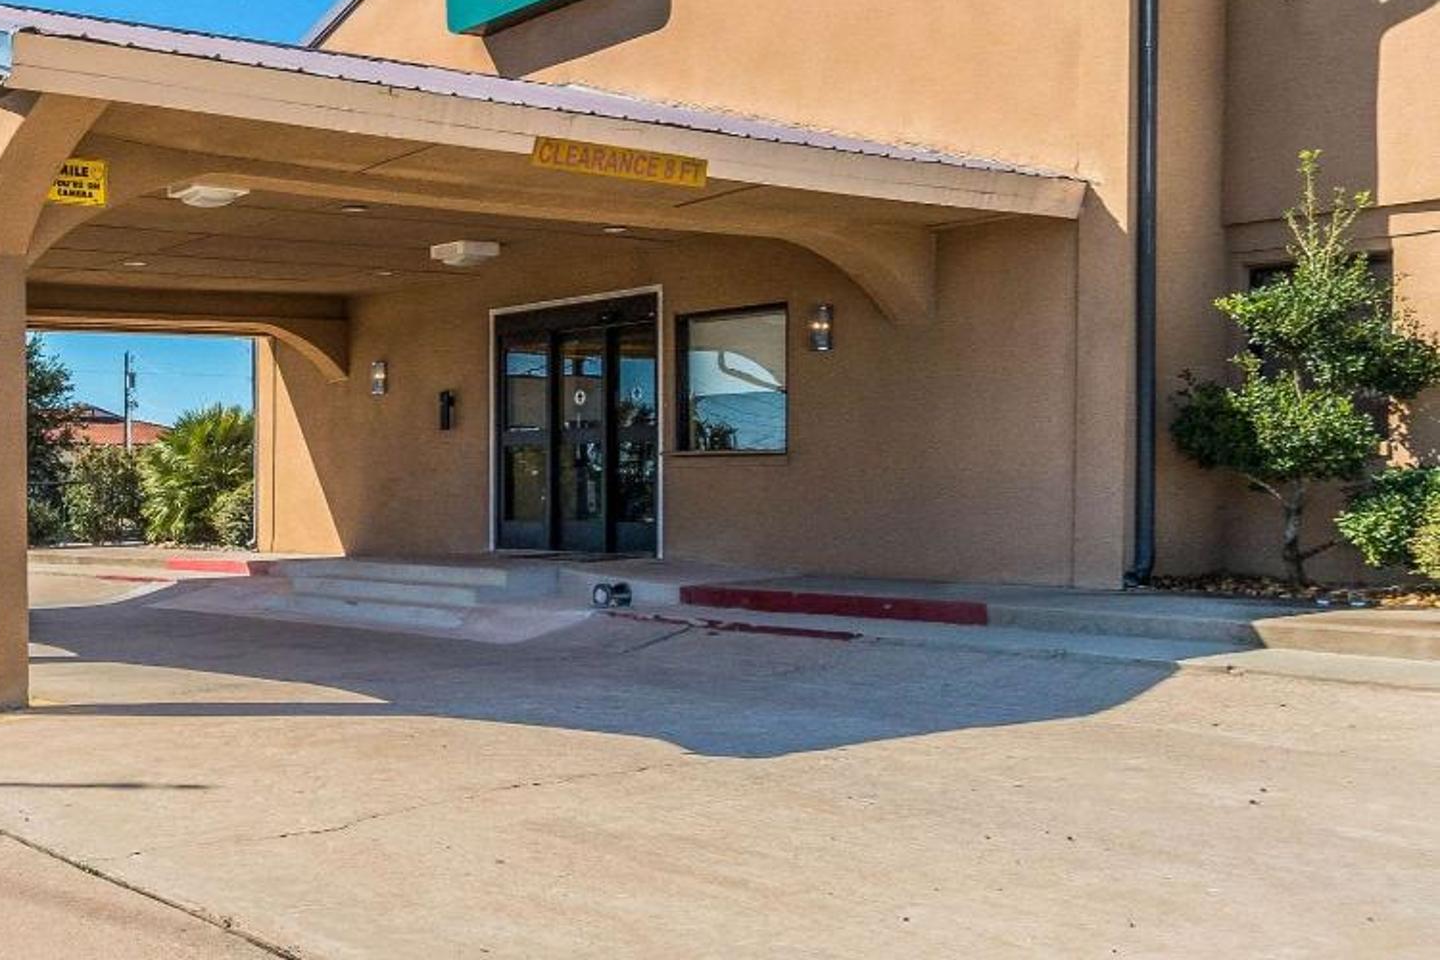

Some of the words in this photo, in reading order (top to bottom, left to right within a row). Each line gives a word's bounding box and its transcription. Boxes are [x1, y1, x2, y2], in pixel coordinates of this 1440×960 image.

[538, 141, 658, 178] CLEARANCE
[663, 158, 676, 180] 8
[678, 161, 703, 183] FT
